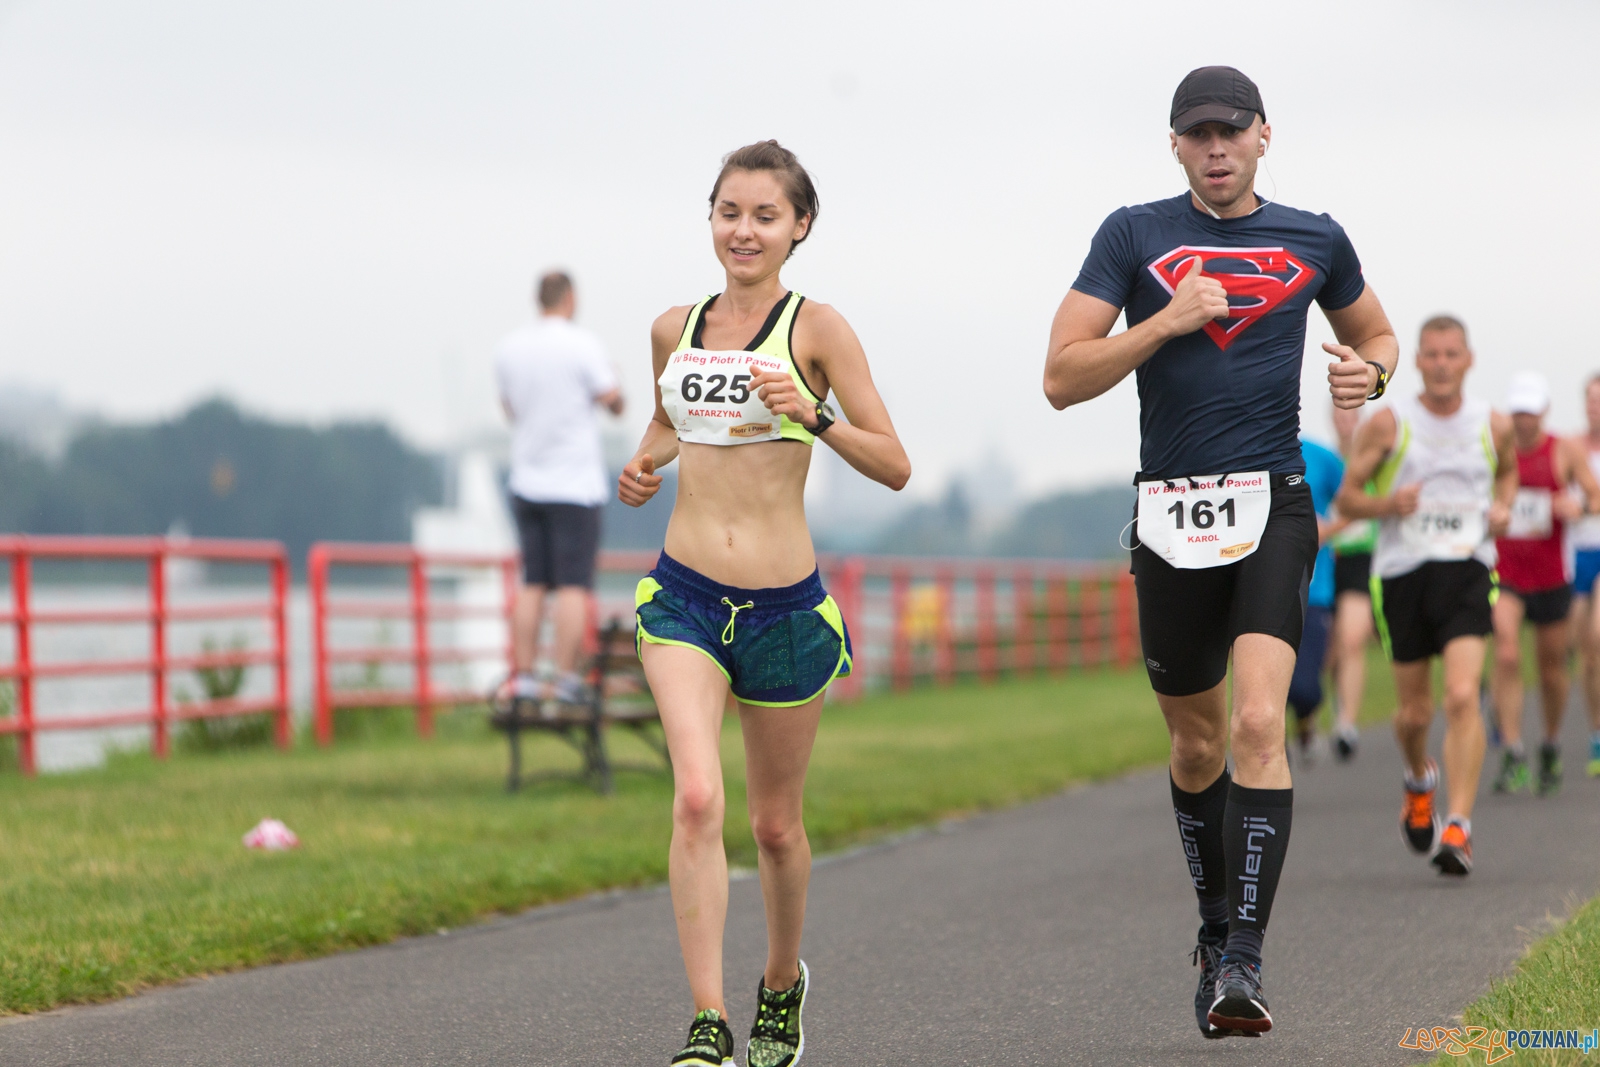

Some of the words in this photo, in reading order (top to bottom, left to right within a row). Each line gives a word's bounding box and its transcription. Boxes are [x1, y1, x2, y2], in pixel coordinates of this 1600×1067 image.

[683, 353, 707, 365] Bieg
[709, 355, 736, 365] Piotr
[738, 355, 742, 364] i
[745, 356, 781, 370] Paweł
[681, 373, 752, 404] 625
[688, 408, 742, 418] KATARZYNA
[1148, 486, 1160, 495] IV
[1226, 477, 1263, 488] Paweł
[1167, 498, 1236, 529] 161
[1187, 534, 1220, 543] KAROL
[1238, 816, 1276, 922] kalenji
